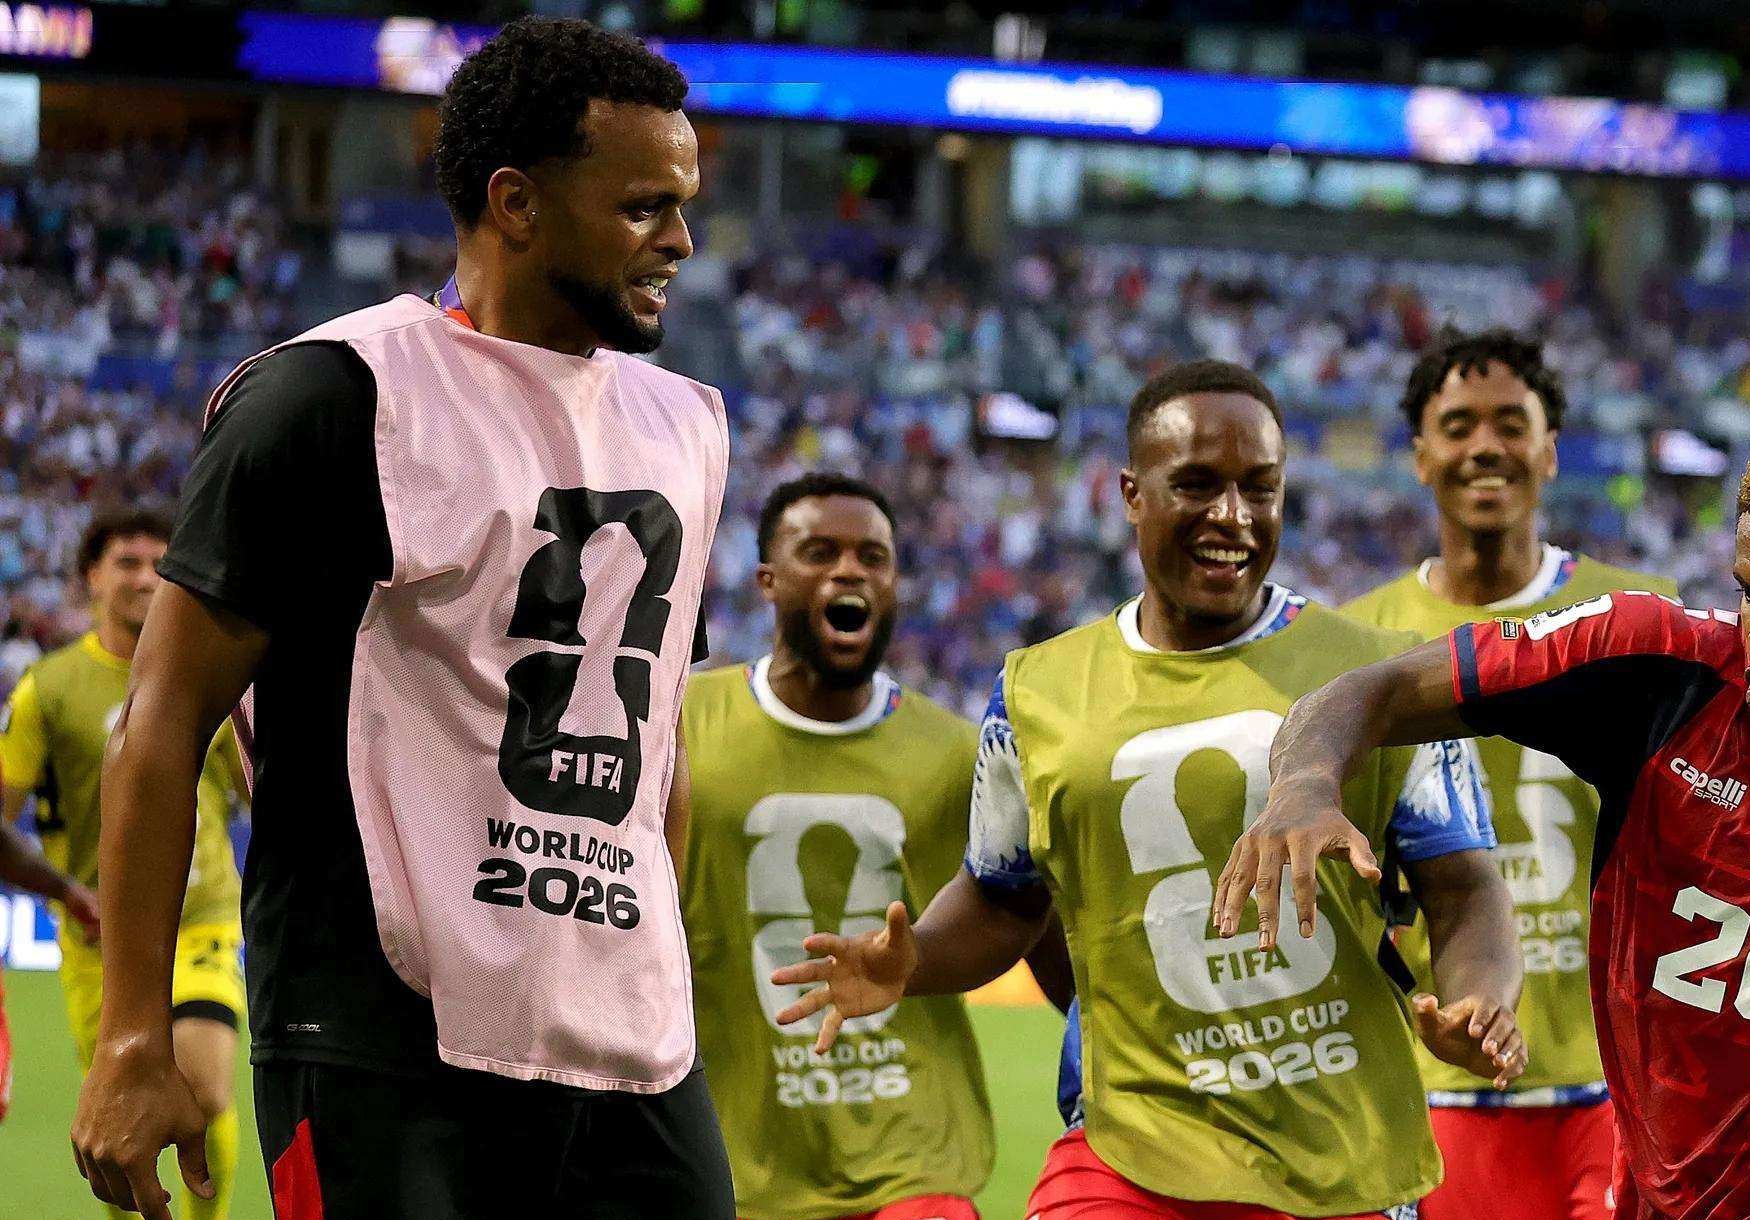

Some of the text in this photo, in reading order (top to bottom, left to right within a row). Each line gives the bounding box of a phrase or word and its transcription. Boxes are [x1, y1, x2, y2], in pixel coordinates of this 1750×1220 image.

[549, 749, 624, 795] FIFA
[1670, 757, 1747, 805] capelli
[1693, 788, 1737, 811] SPORT
[487, 817, 635, 876] WORLD CUP
[473, 857, 641, 931] 2026
[1206, 944, 1292, 985] FIFA
[1521, 937, 1587, 973] 26
[1175, 998, 1350, 1057] WORLD CUP
[1185, 1031, 1360, 1096] 2026
